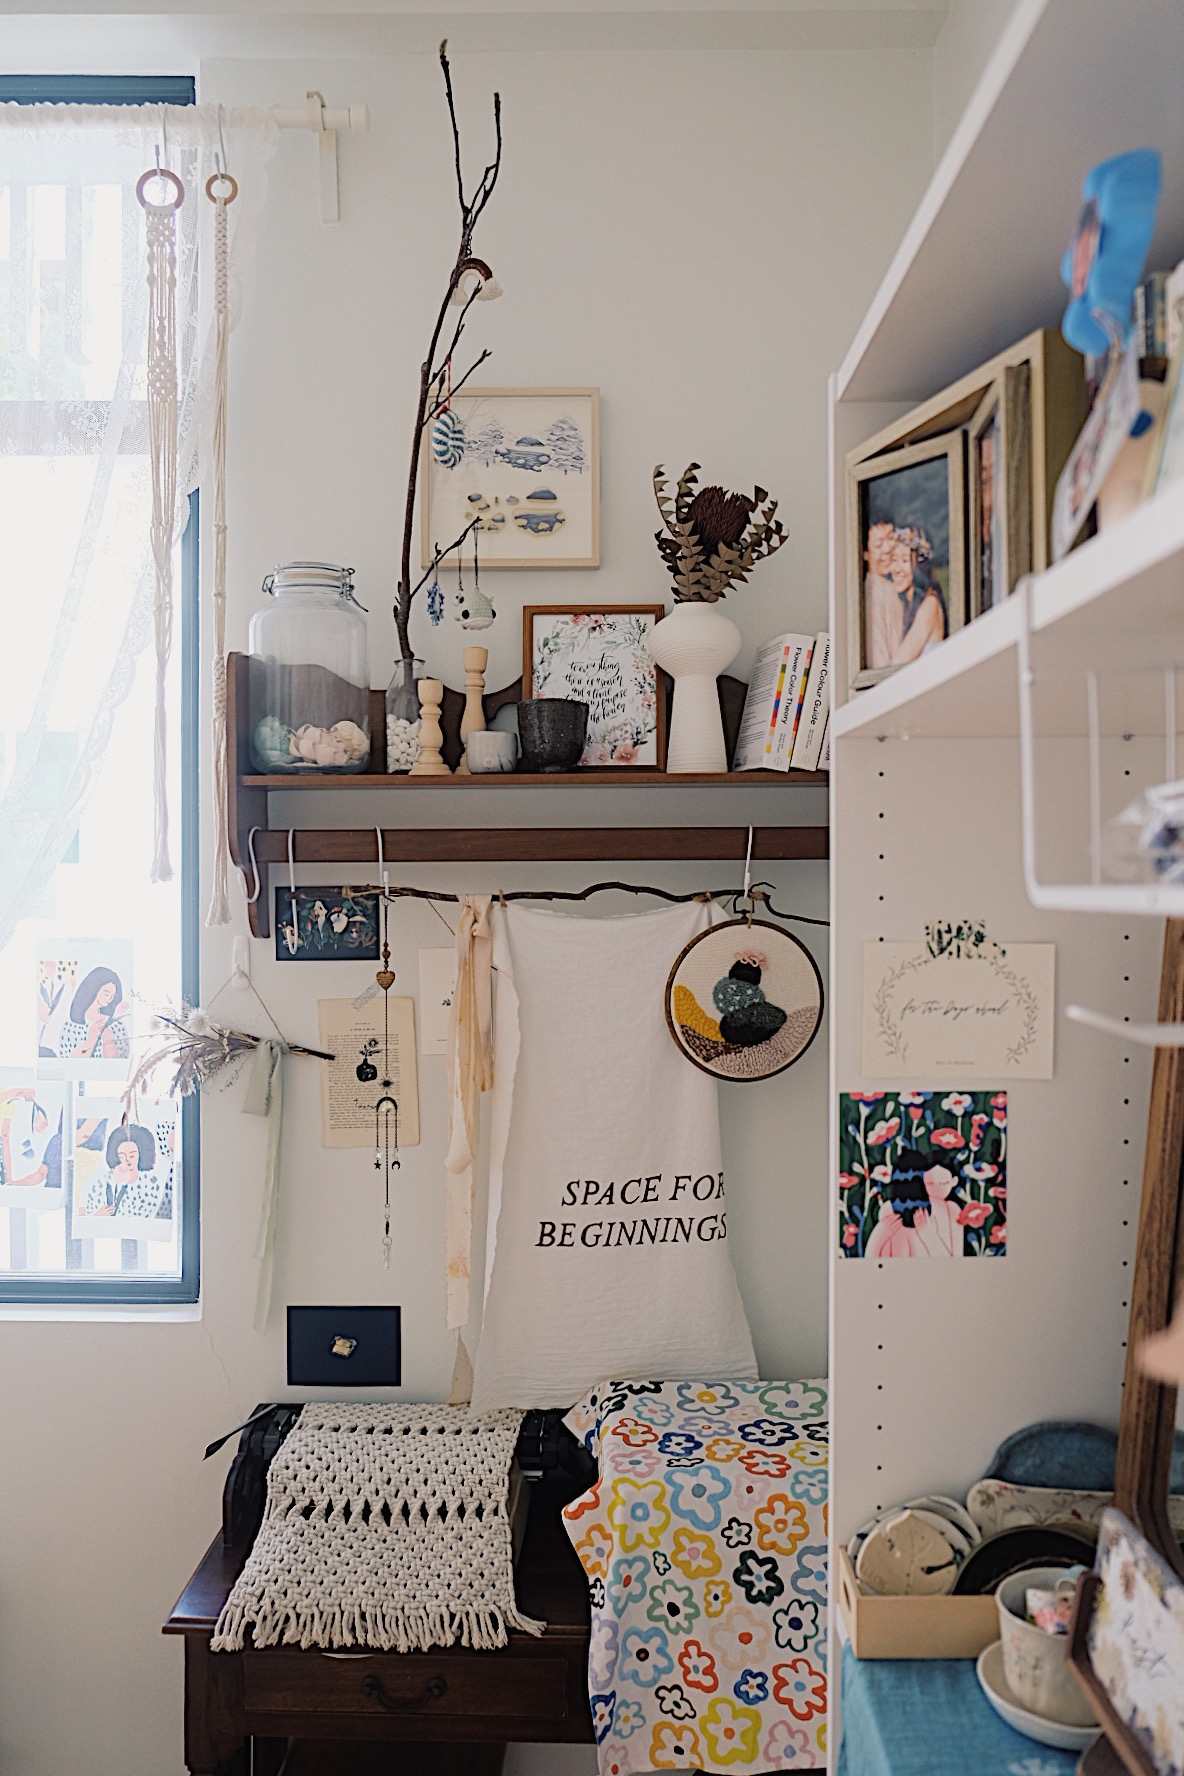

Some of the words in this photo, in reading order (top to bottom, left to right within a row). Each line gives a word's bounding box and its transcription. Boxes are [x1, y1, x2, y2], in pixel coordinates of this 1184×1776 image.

[792, 647, 802, 673] Flower
[822, 640, 830, 668] lower
[787, 674, 797, 696] Color
[817, 669, 828, 697] Colour
[781, 697, 793, 725] Theory
[811, 699, 822, 726] Guide
[561, 1173, 662, 1207] SPACE
[669, 1171, 726, 1201] FOR
[535, 1212, 727, 1248] BEGINNINGS
